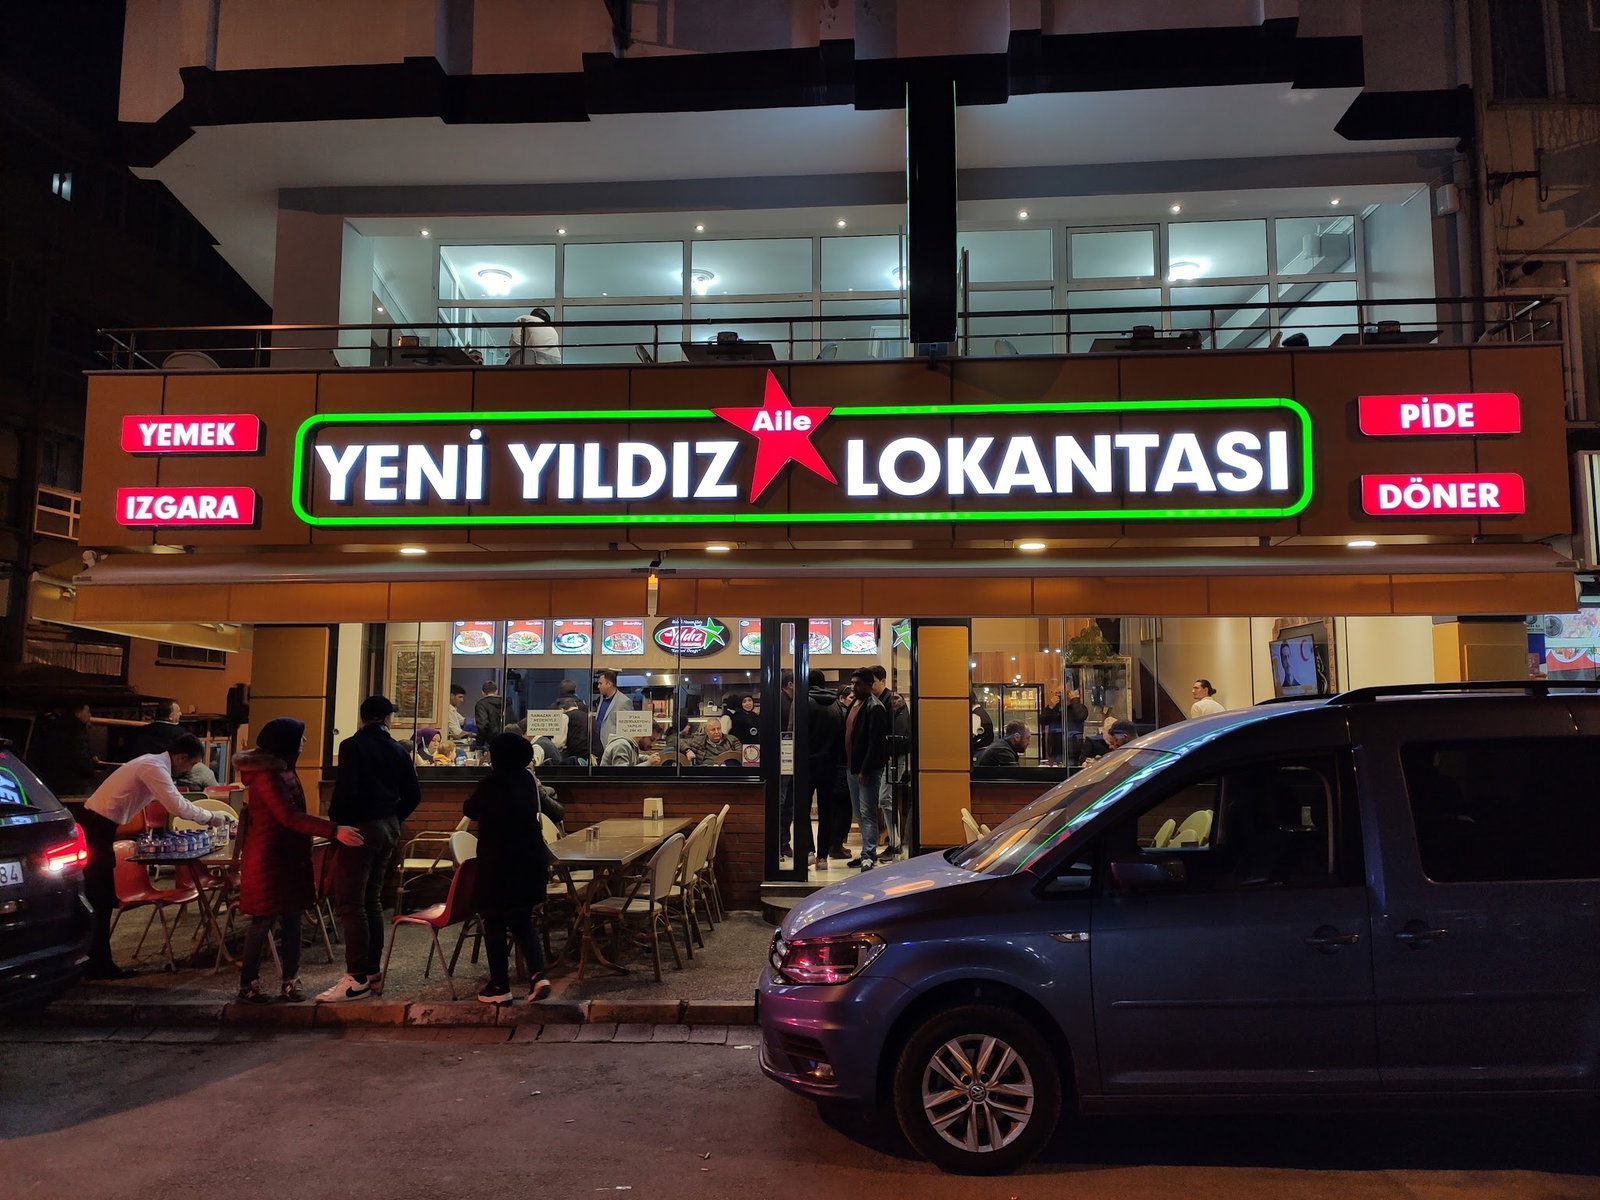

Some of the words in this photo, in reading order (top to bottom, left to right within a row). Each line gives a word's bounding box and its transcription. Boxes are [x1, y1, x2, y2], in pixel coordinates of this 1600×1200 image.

[751, 410, 812, 432] Aile
[1400, 397, 1475, 429] PİDE
[139, 422, 236, 446] YEMEK
[314, 428, 483, 502] YENİ
[507, 440, 740, 500] YILDIZ
[847, 430, 1290, 497] LOKANTASI
[126, 494, 239, 520] IZGARA
[1378, 476, 1501, 510] DÖNER
